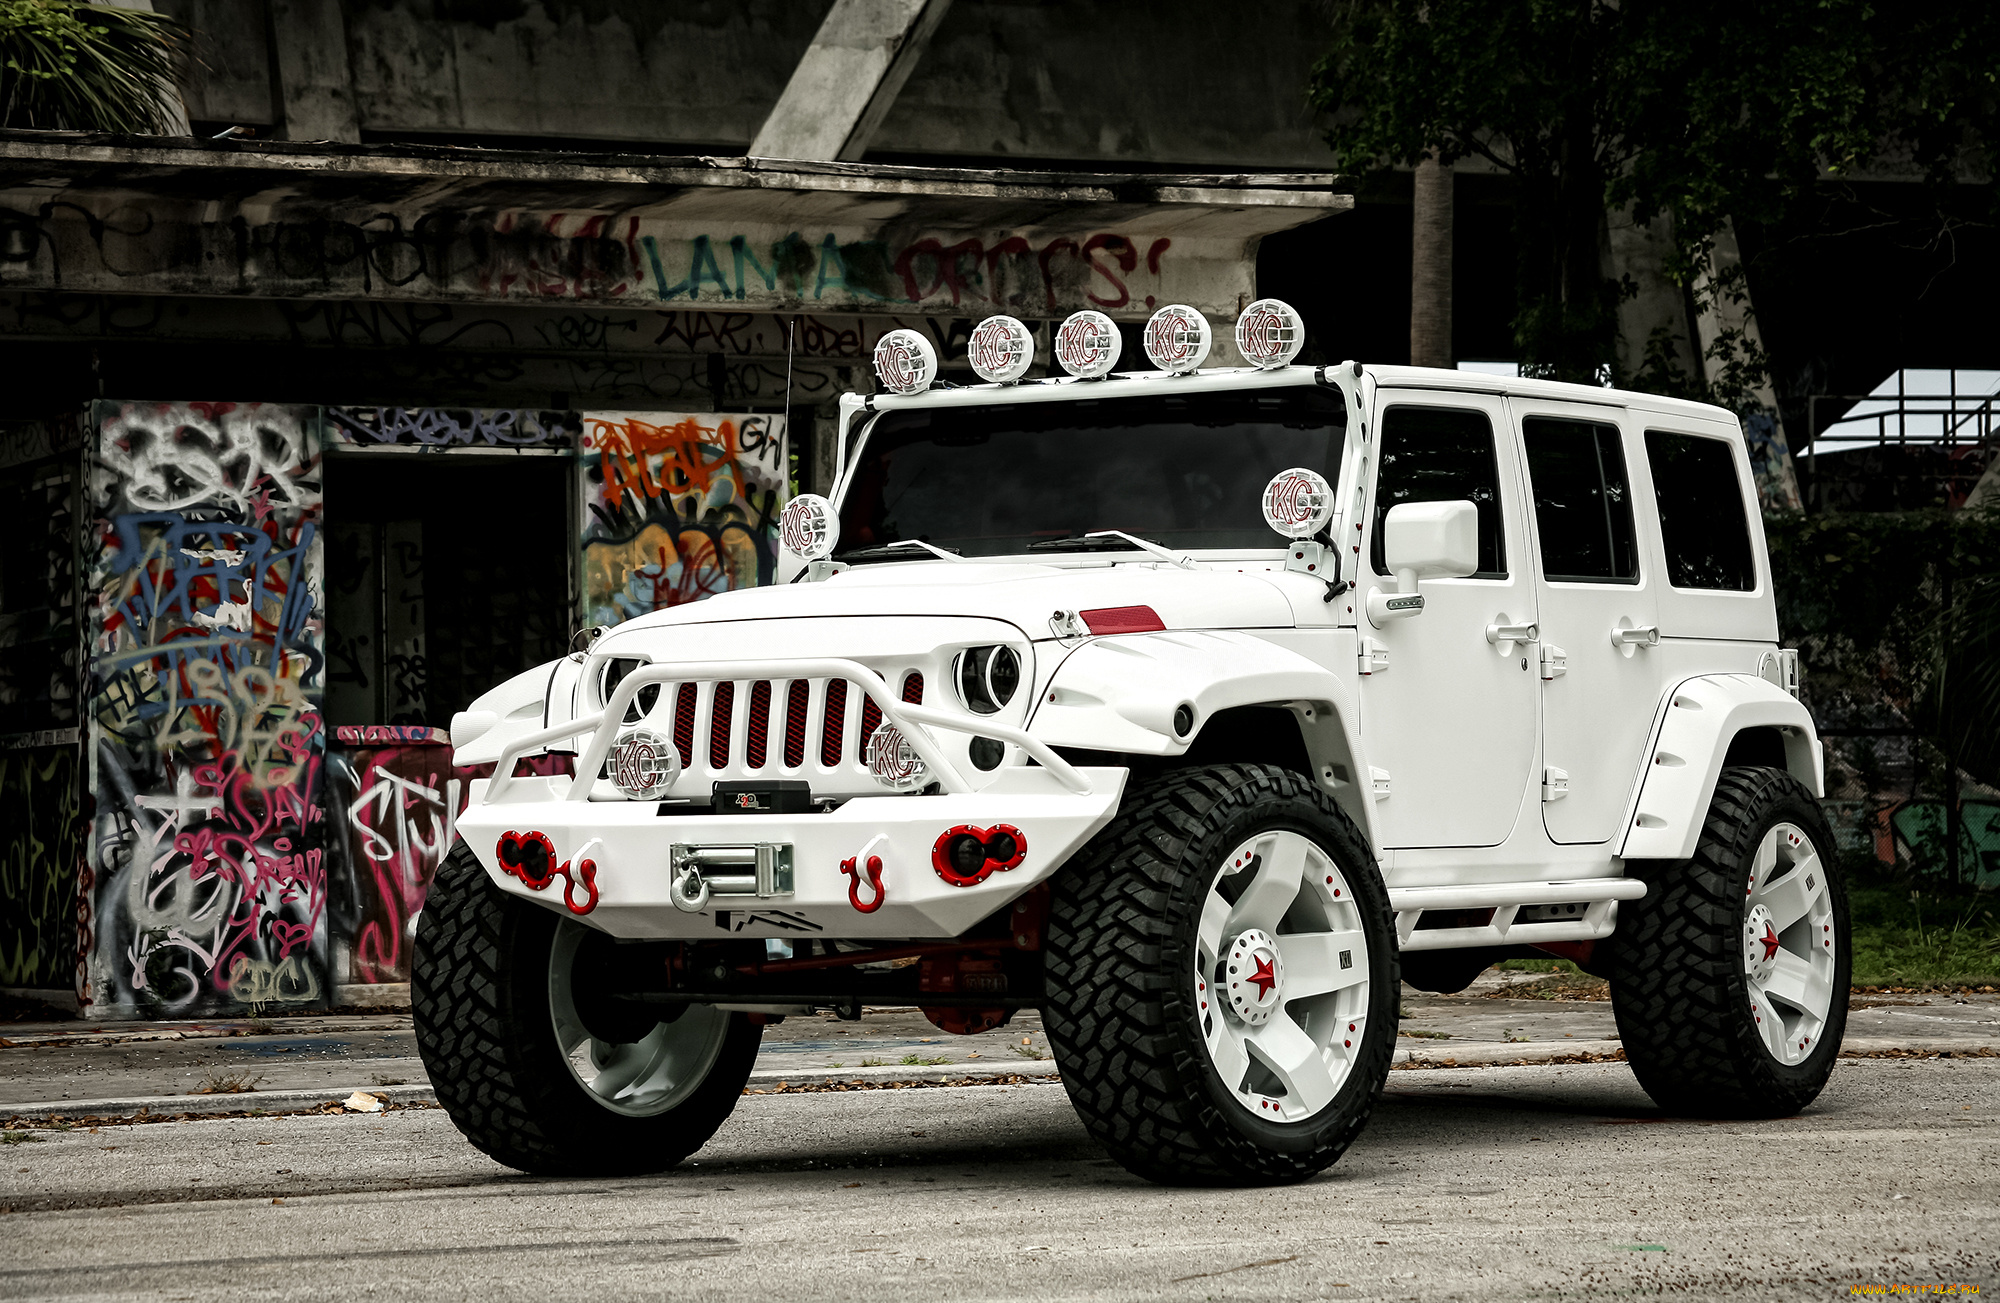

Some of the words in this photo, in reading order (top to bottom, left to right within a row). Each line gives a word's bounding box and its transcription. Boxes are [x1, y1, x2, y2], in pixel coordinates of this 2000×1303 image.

[975, 324, 1010, 370] KC
[1062, 319, 1098, 366] KC
[1151, 314, 1188, 361] KC
[1243, 310, 1282, 358] KC
[879, 345, 914, 389] KC
[1272, 476, 1312, 524] KC
[781, 504, 815, 551] KC
[615, 741, 655, 791] KC
